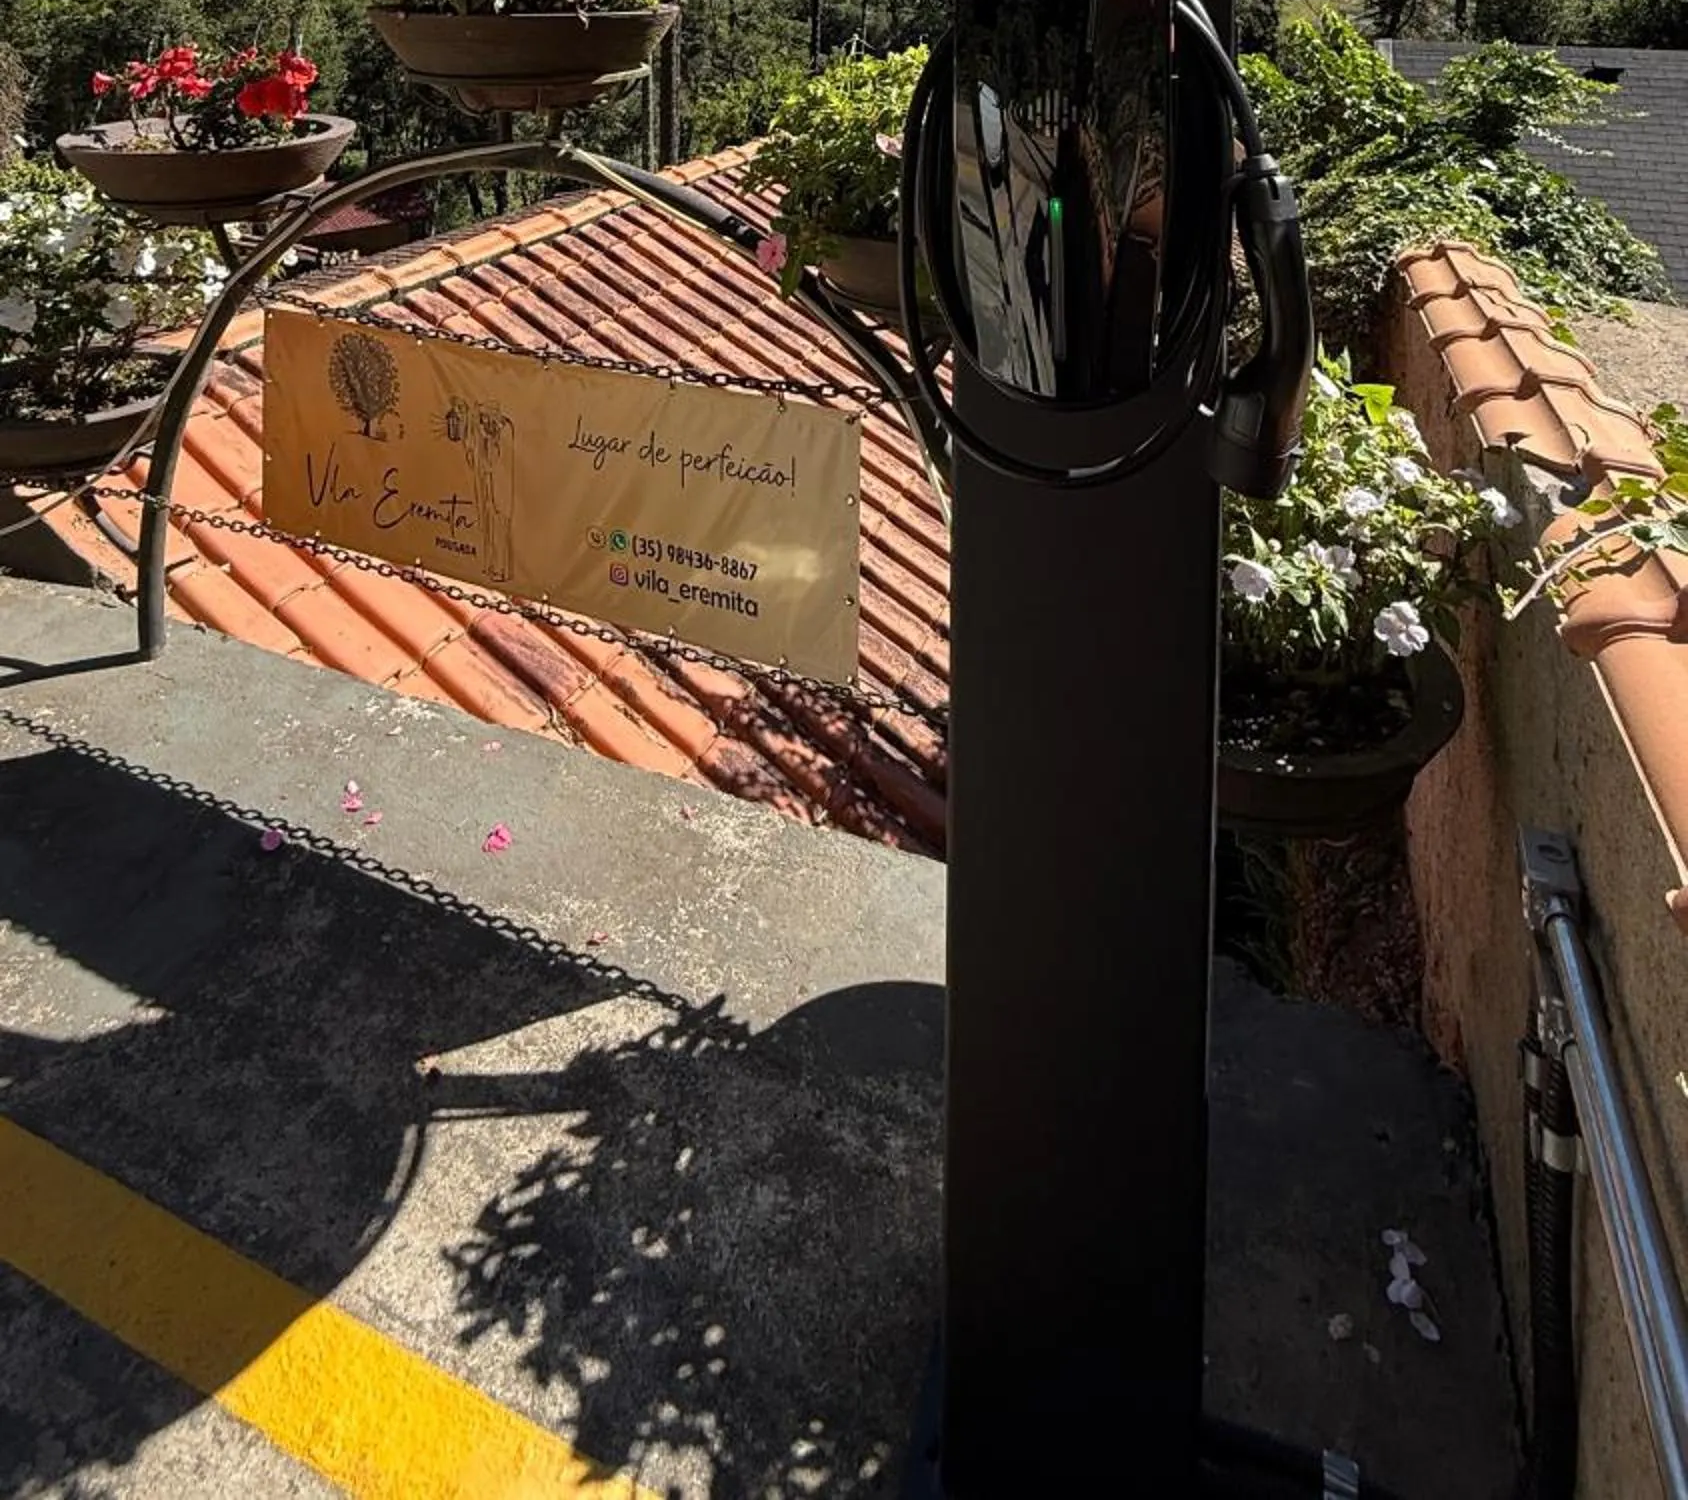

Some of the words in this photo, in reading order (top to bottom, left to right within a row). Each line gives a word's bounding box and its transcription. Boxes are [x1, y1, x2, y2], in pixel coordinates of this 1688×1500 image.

[567, 414, 632, 471] Lugar
[639, 431, 672, 468] de
[680, 443, 797, 498] perfeição!
[373, 467, 480, 538] Eremita
[631, 534, 663, 562] (35)
[667, 544, 759, 581] 98436-8867
[633, 569, 760, 618] vila_eremita
